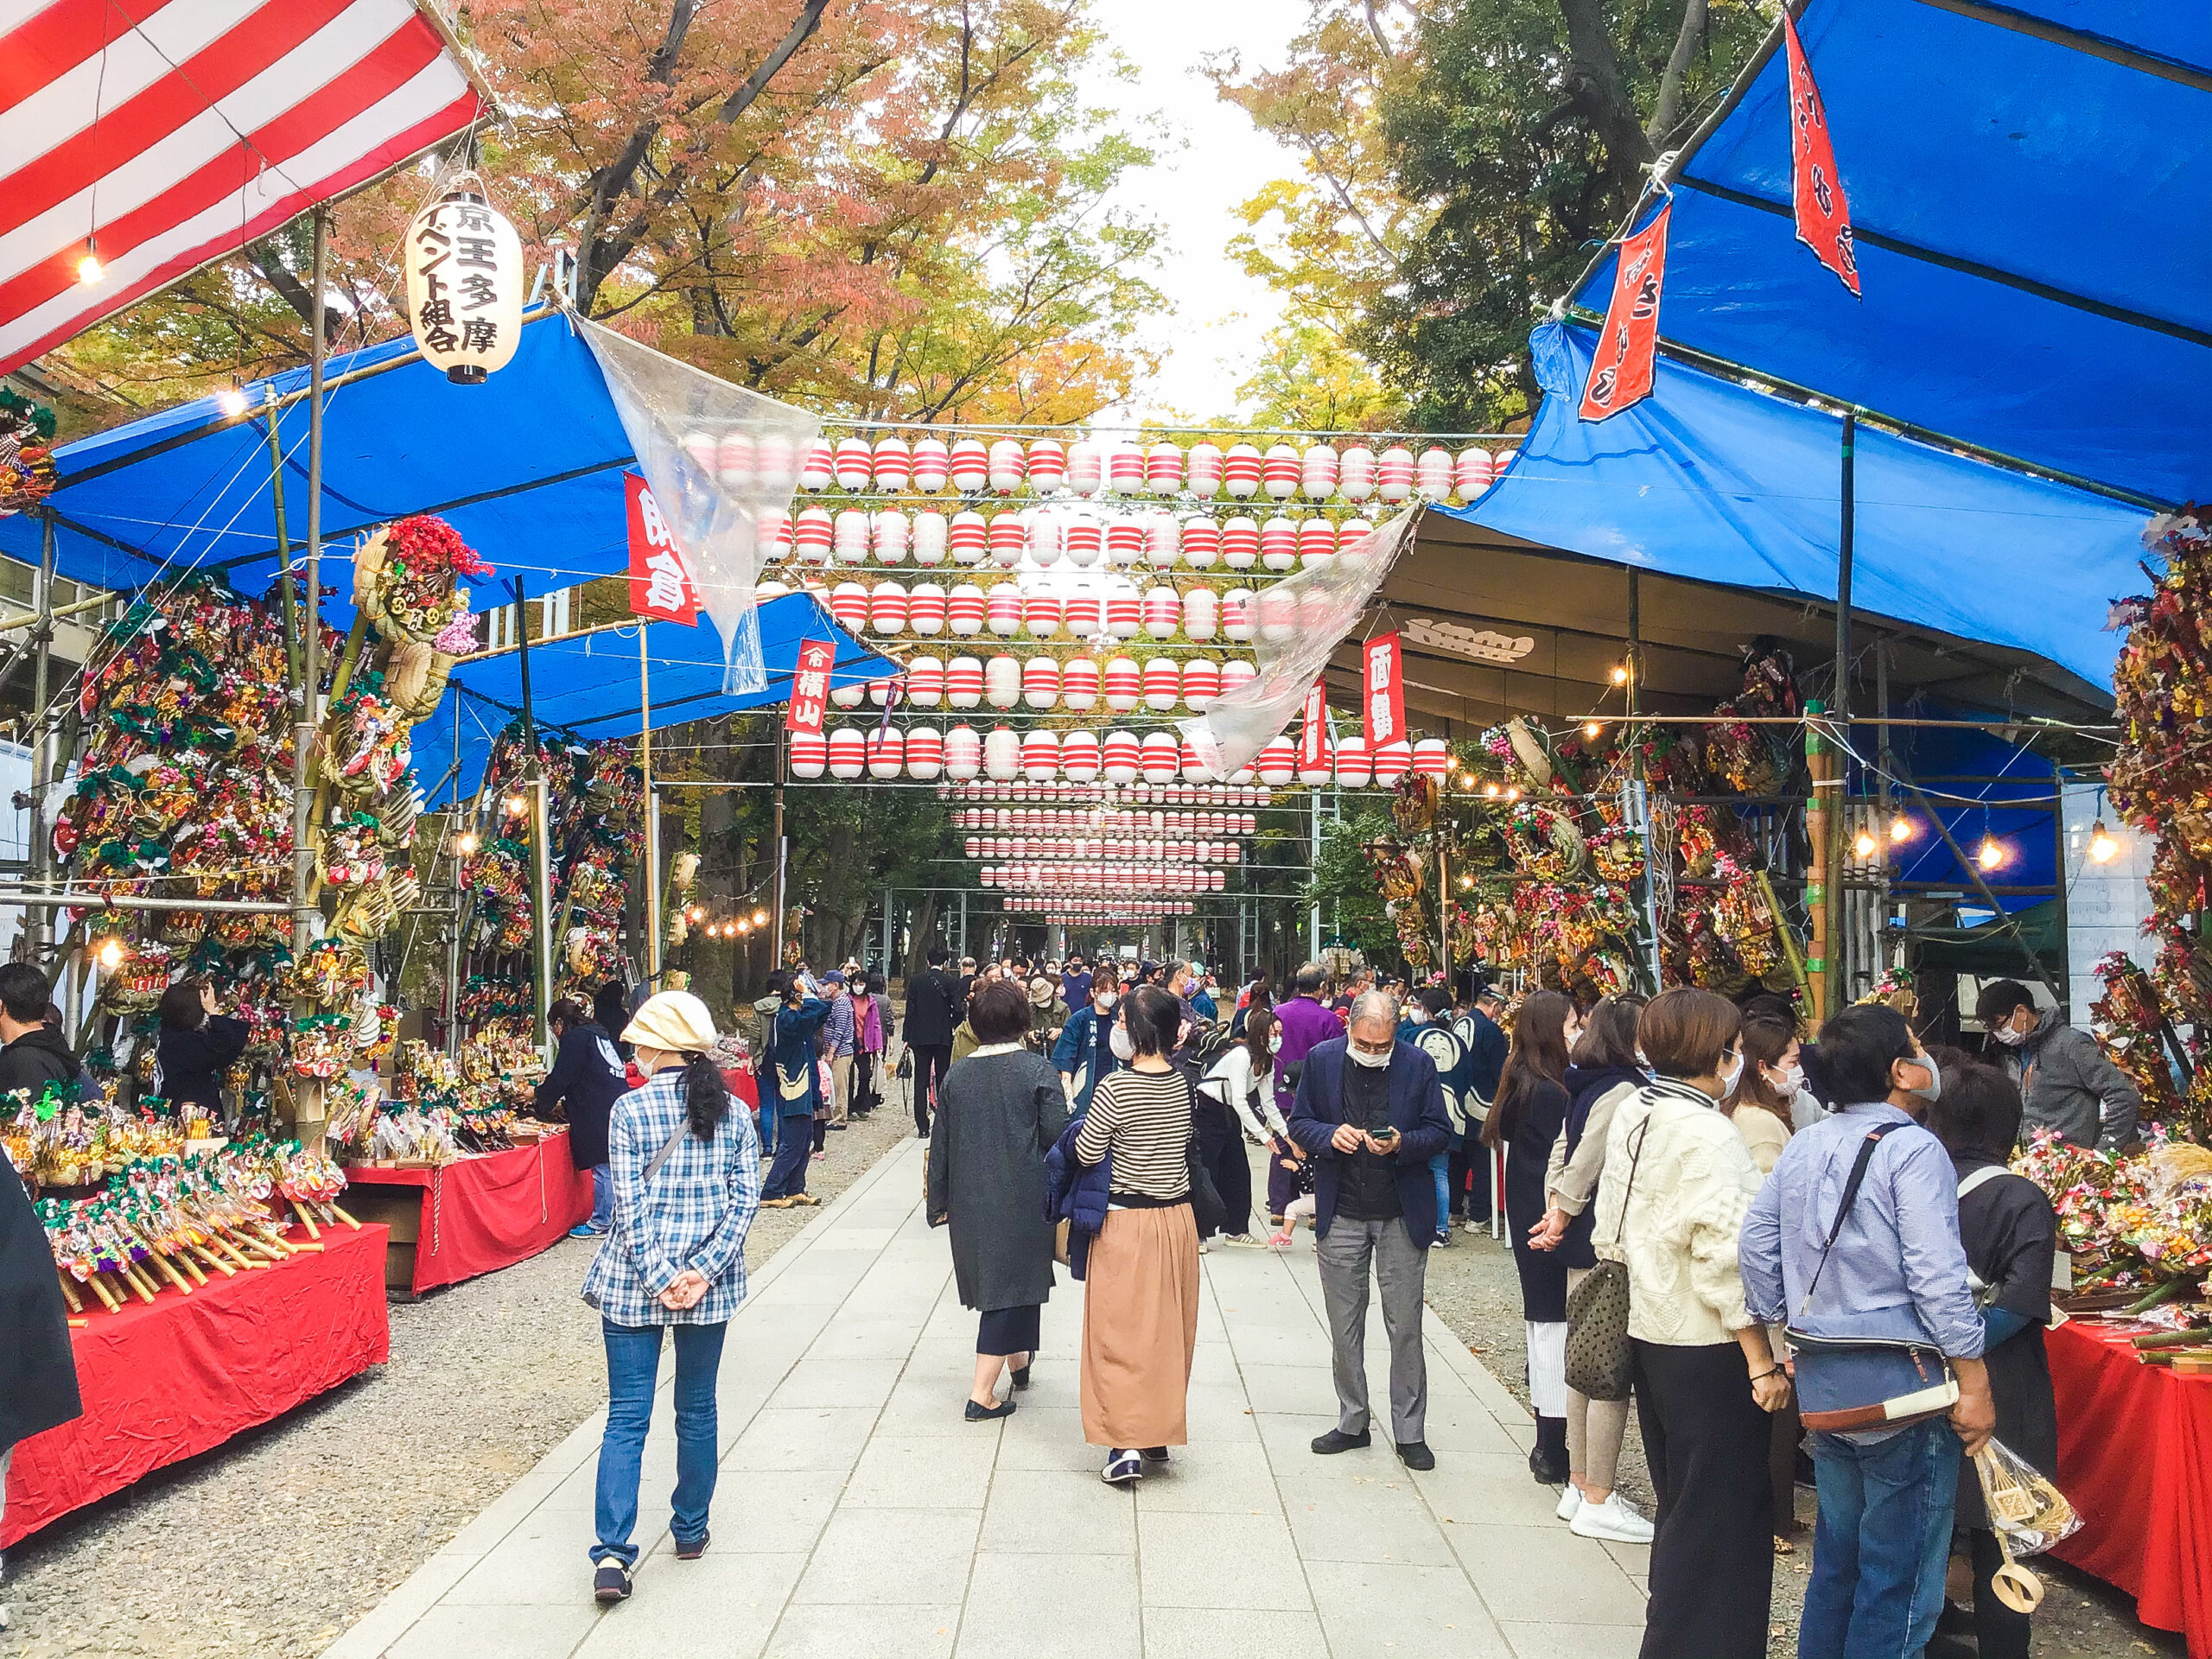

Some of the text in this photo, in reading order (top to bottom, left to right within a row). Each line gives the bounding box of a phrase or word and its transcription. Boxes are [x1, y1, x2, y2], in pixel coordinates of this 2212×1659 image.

[416, 204, 460, 354] イベント組合
[455, 204, 498, 354] 京王多摩
[794, 669, 826, 728] 横山
